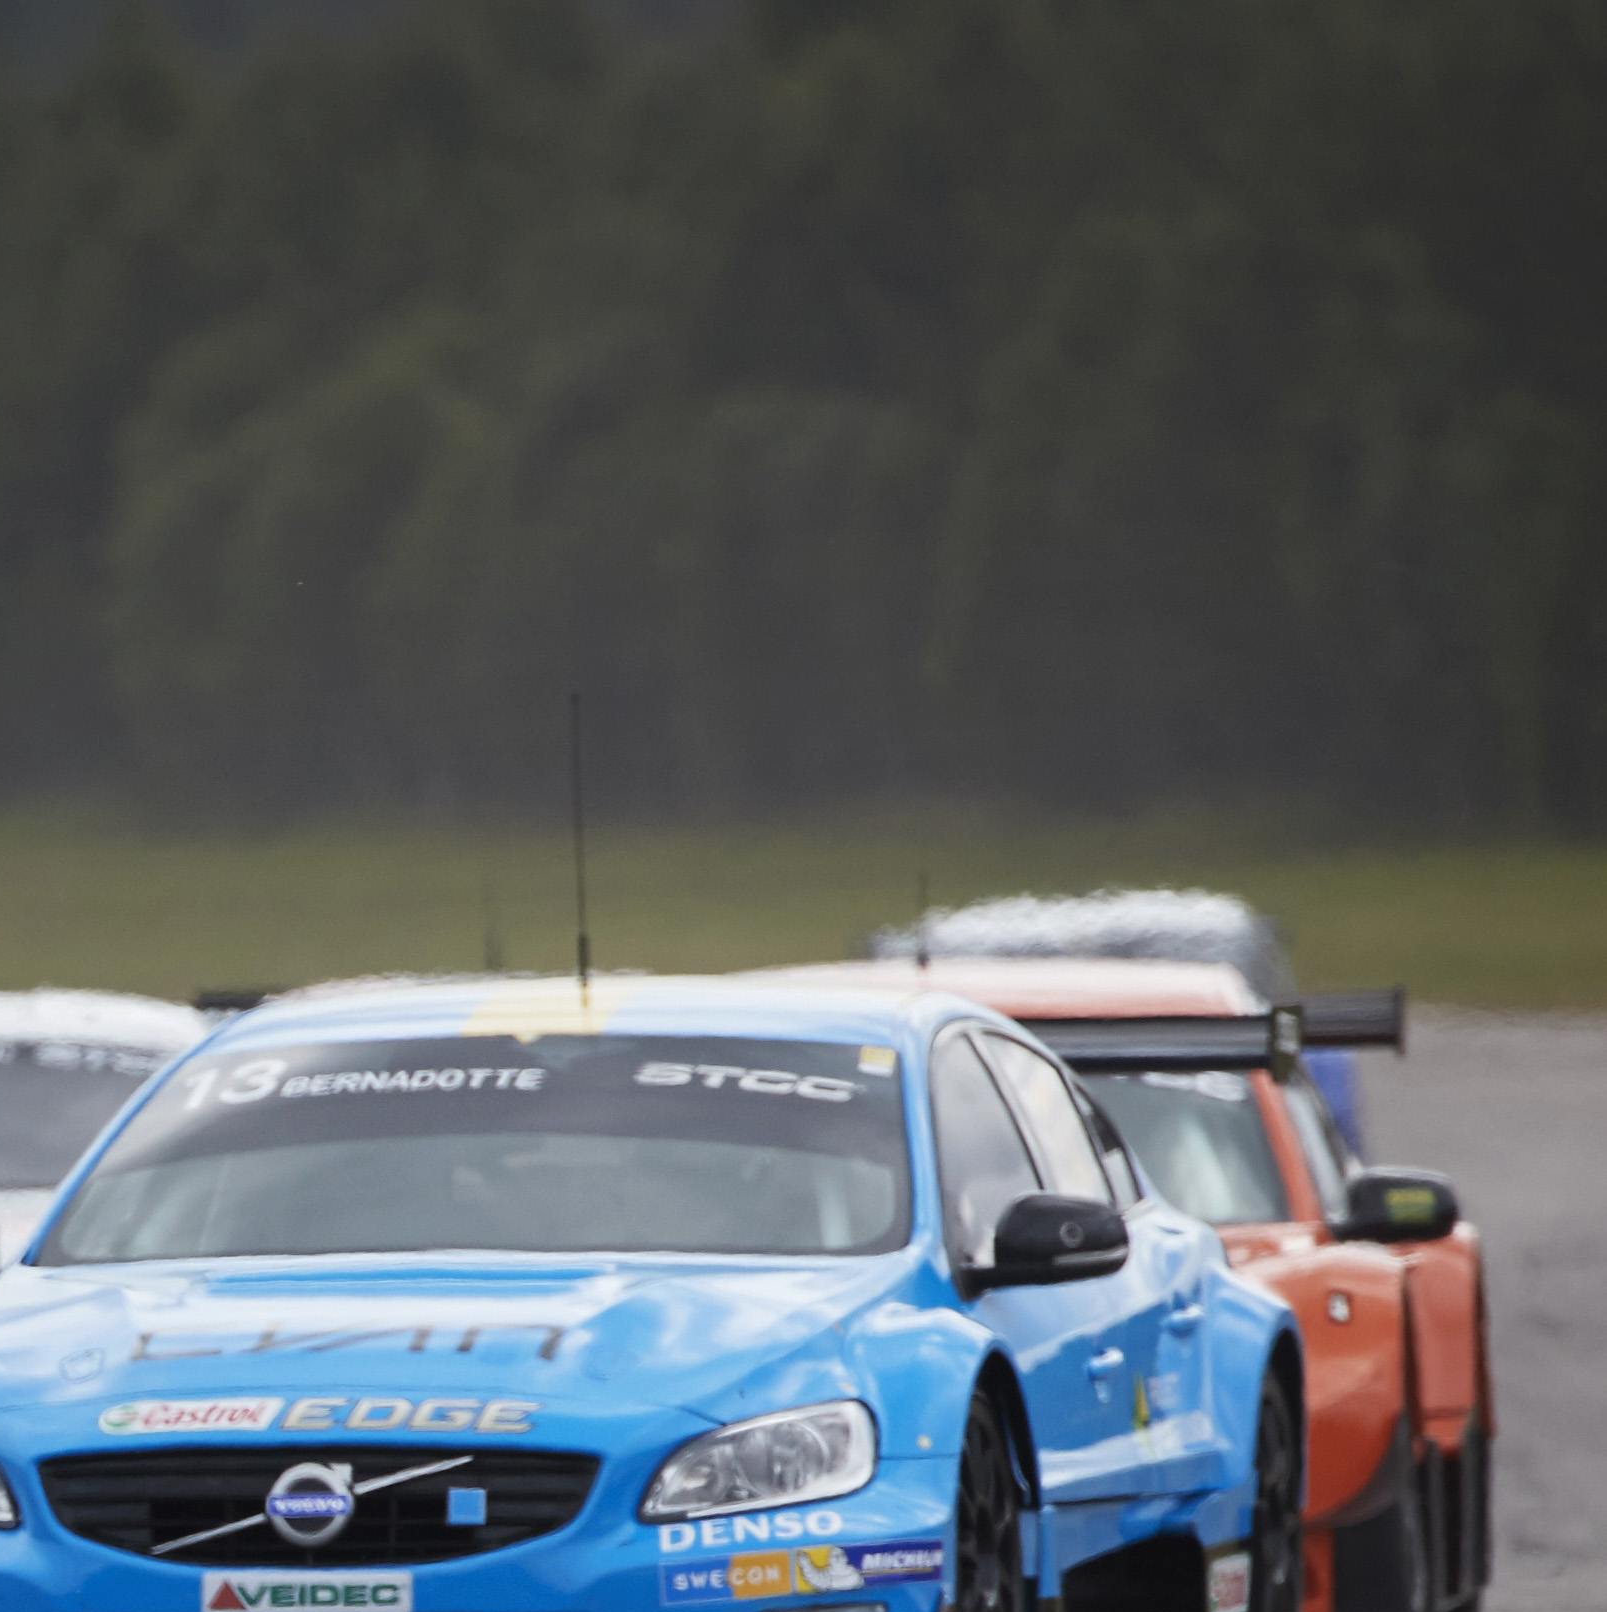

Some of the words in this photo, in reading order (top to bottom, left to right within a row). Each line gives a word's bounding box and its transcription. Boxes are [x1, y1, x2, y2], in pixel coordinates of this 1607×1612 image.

[183, 1060, 286, 1111] 13
[280, 1068, 546, 1099] BERNADOTTE
[635, 1061, 859, 1102] STCC
[144, 1402, 268, 1429] Castrol
[279, 1398, 543, 1435] EDGE
[658, 1510, 843, 1553] DENSO
[238, 1584, 400, 1607] VEIDEC
